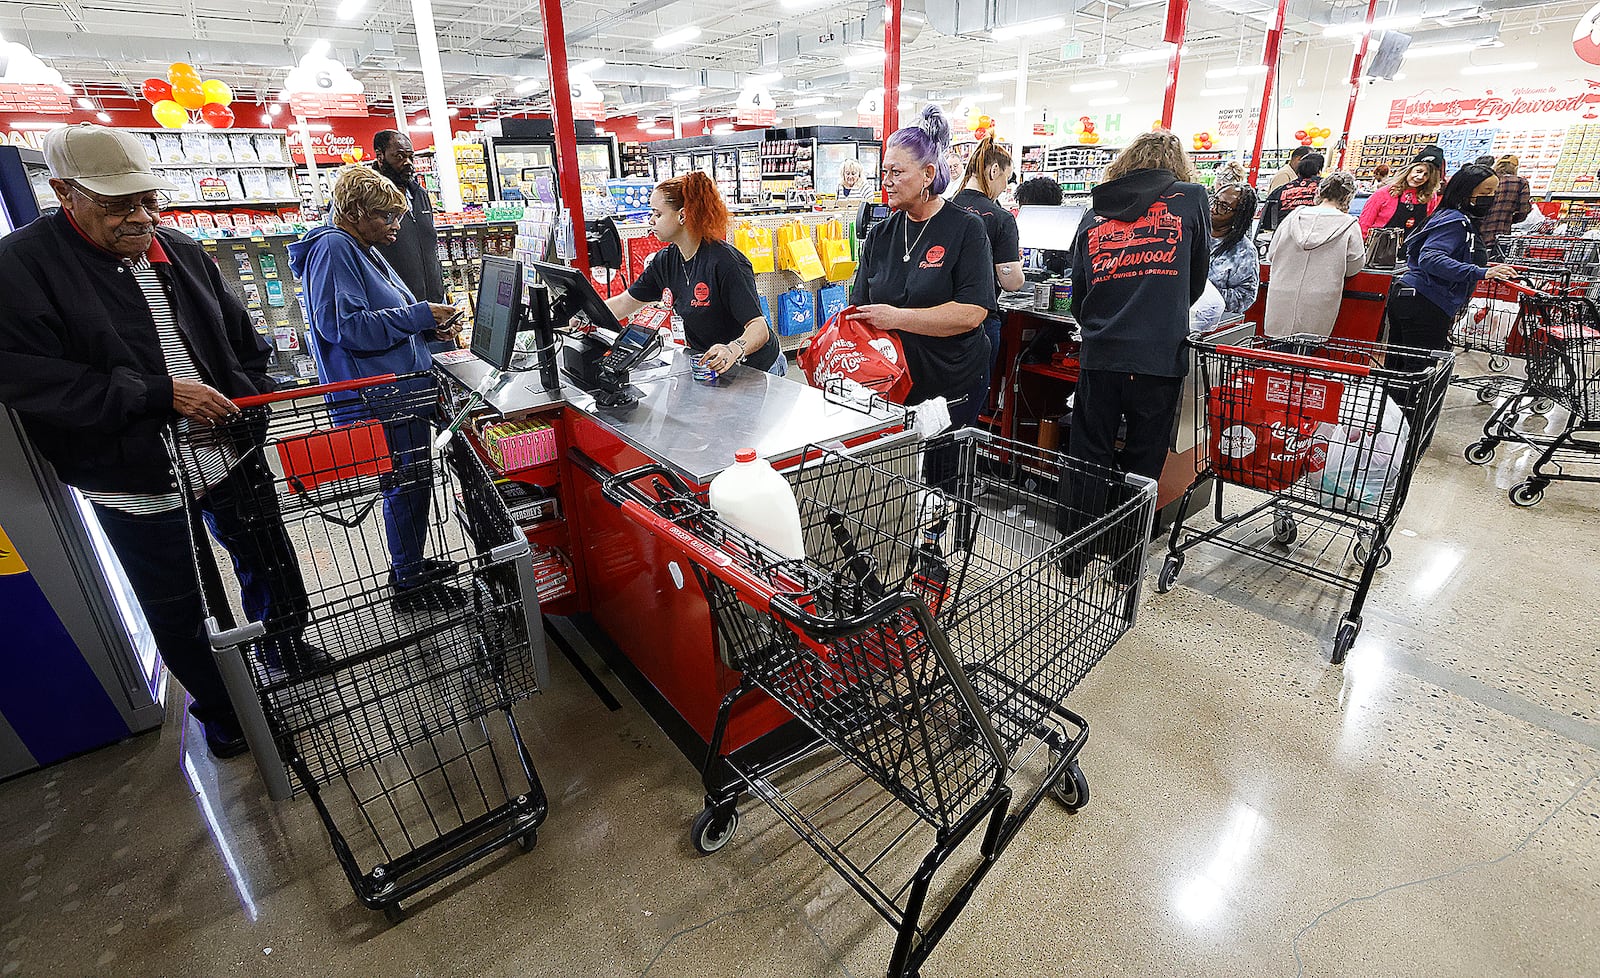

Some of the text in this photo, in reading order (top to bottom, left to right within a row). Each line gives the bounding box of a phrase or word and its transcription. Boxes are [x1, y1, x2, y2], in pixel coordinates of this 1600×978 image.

[315, 71, 333, 89] 6
[571, 84, 582, 98] 5
[1511, 85, 1557, 97] Welcome to
[752, 93, 761, 106] 4
[869, 101, 876, 112] 3
[1476, 93, 1585, 121] Englewood
[287, 131, 355, 145] Mre Cheese
[1091, 245, 1177, 275] Englewood
[1112, 271, 1137, 280] OWNED
[1144, 269, 1179, 277] OPERATED
[668, 526, 713, 555] GROCERY OUTLET
